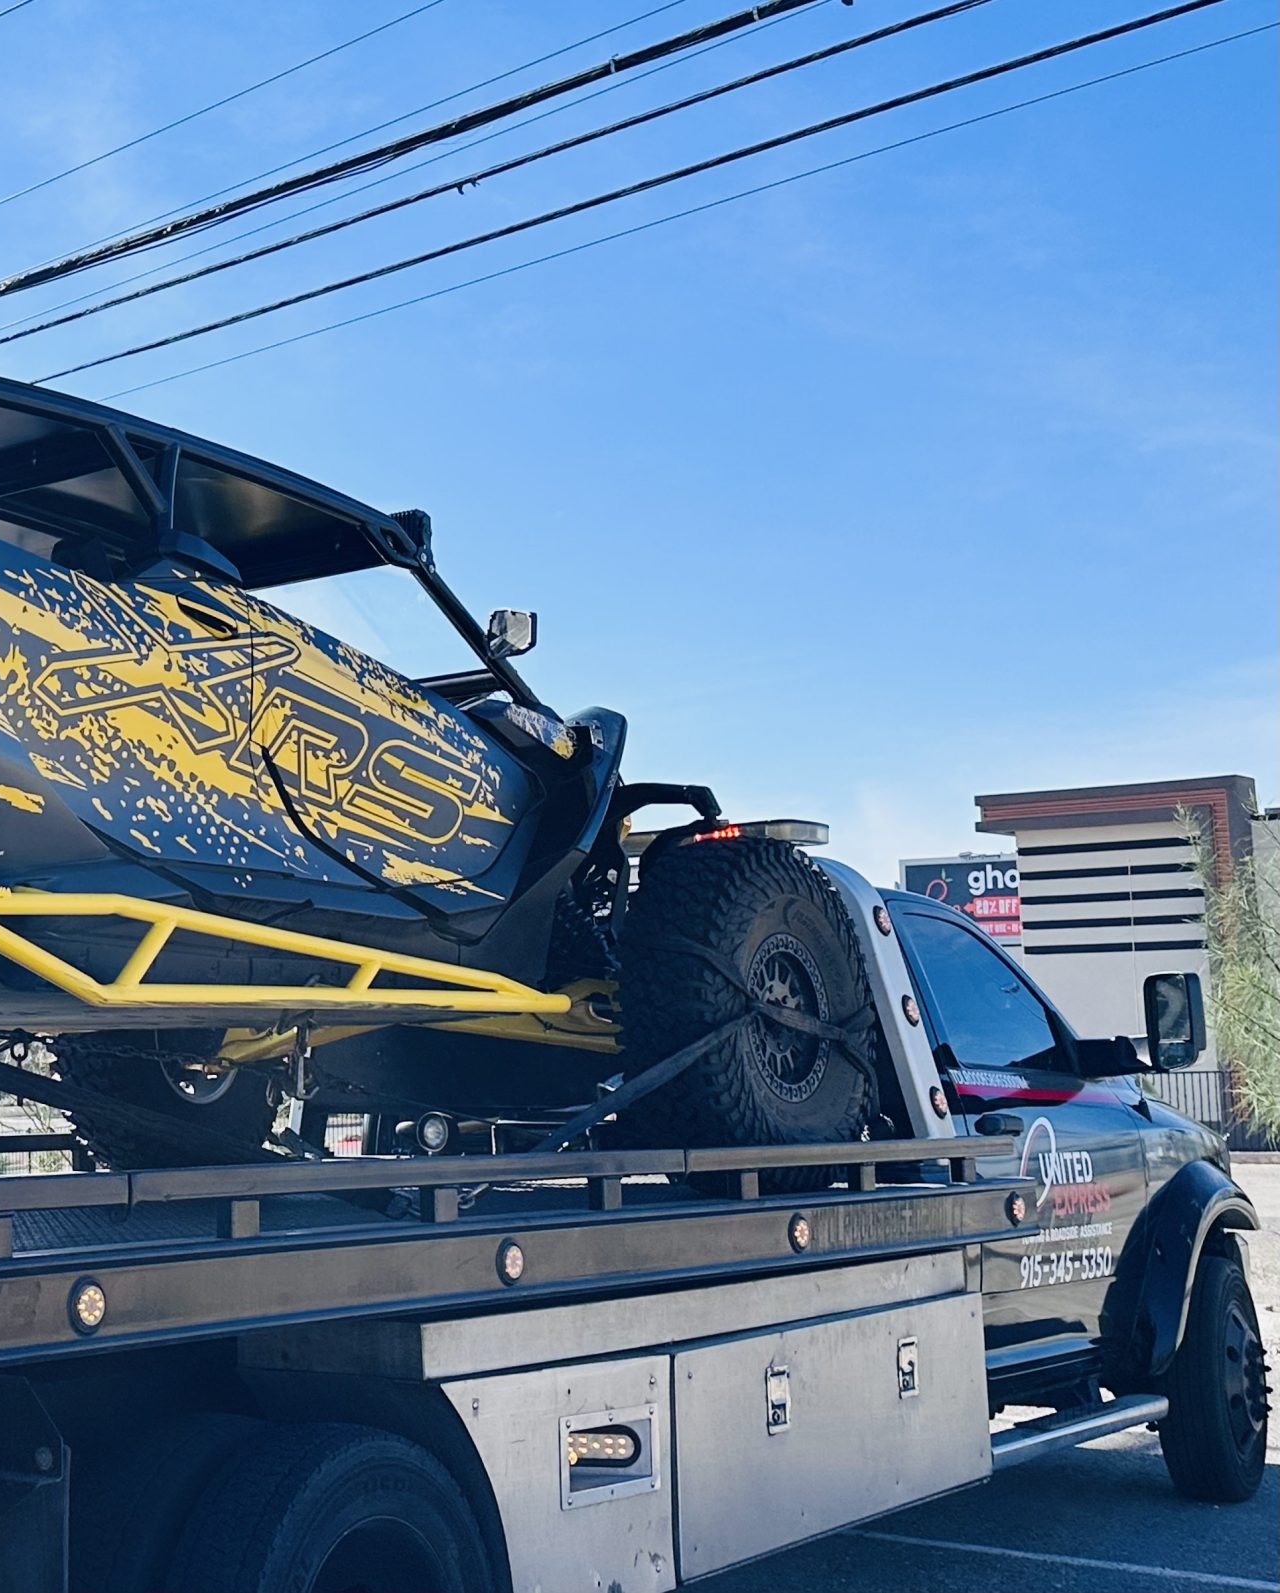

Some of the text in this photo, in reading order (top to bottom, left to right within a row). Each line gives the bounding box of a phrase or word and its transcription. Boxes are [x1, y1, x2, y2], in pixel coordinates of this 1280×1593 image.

[968, 864, 1020, 896] gho
[999, 899, 1018, 914] OFF
[1038, 1151, 1093, 1185] UNITED
[1053, 1184, 1111, 1216] EXPRESS
[1050, 1226, 1079, 1242] ROADSIDE
[1080, 1222, 1113, 1238] ASSISTANCE
[1020, 1246, 1113, 1289] 915-345-5350
